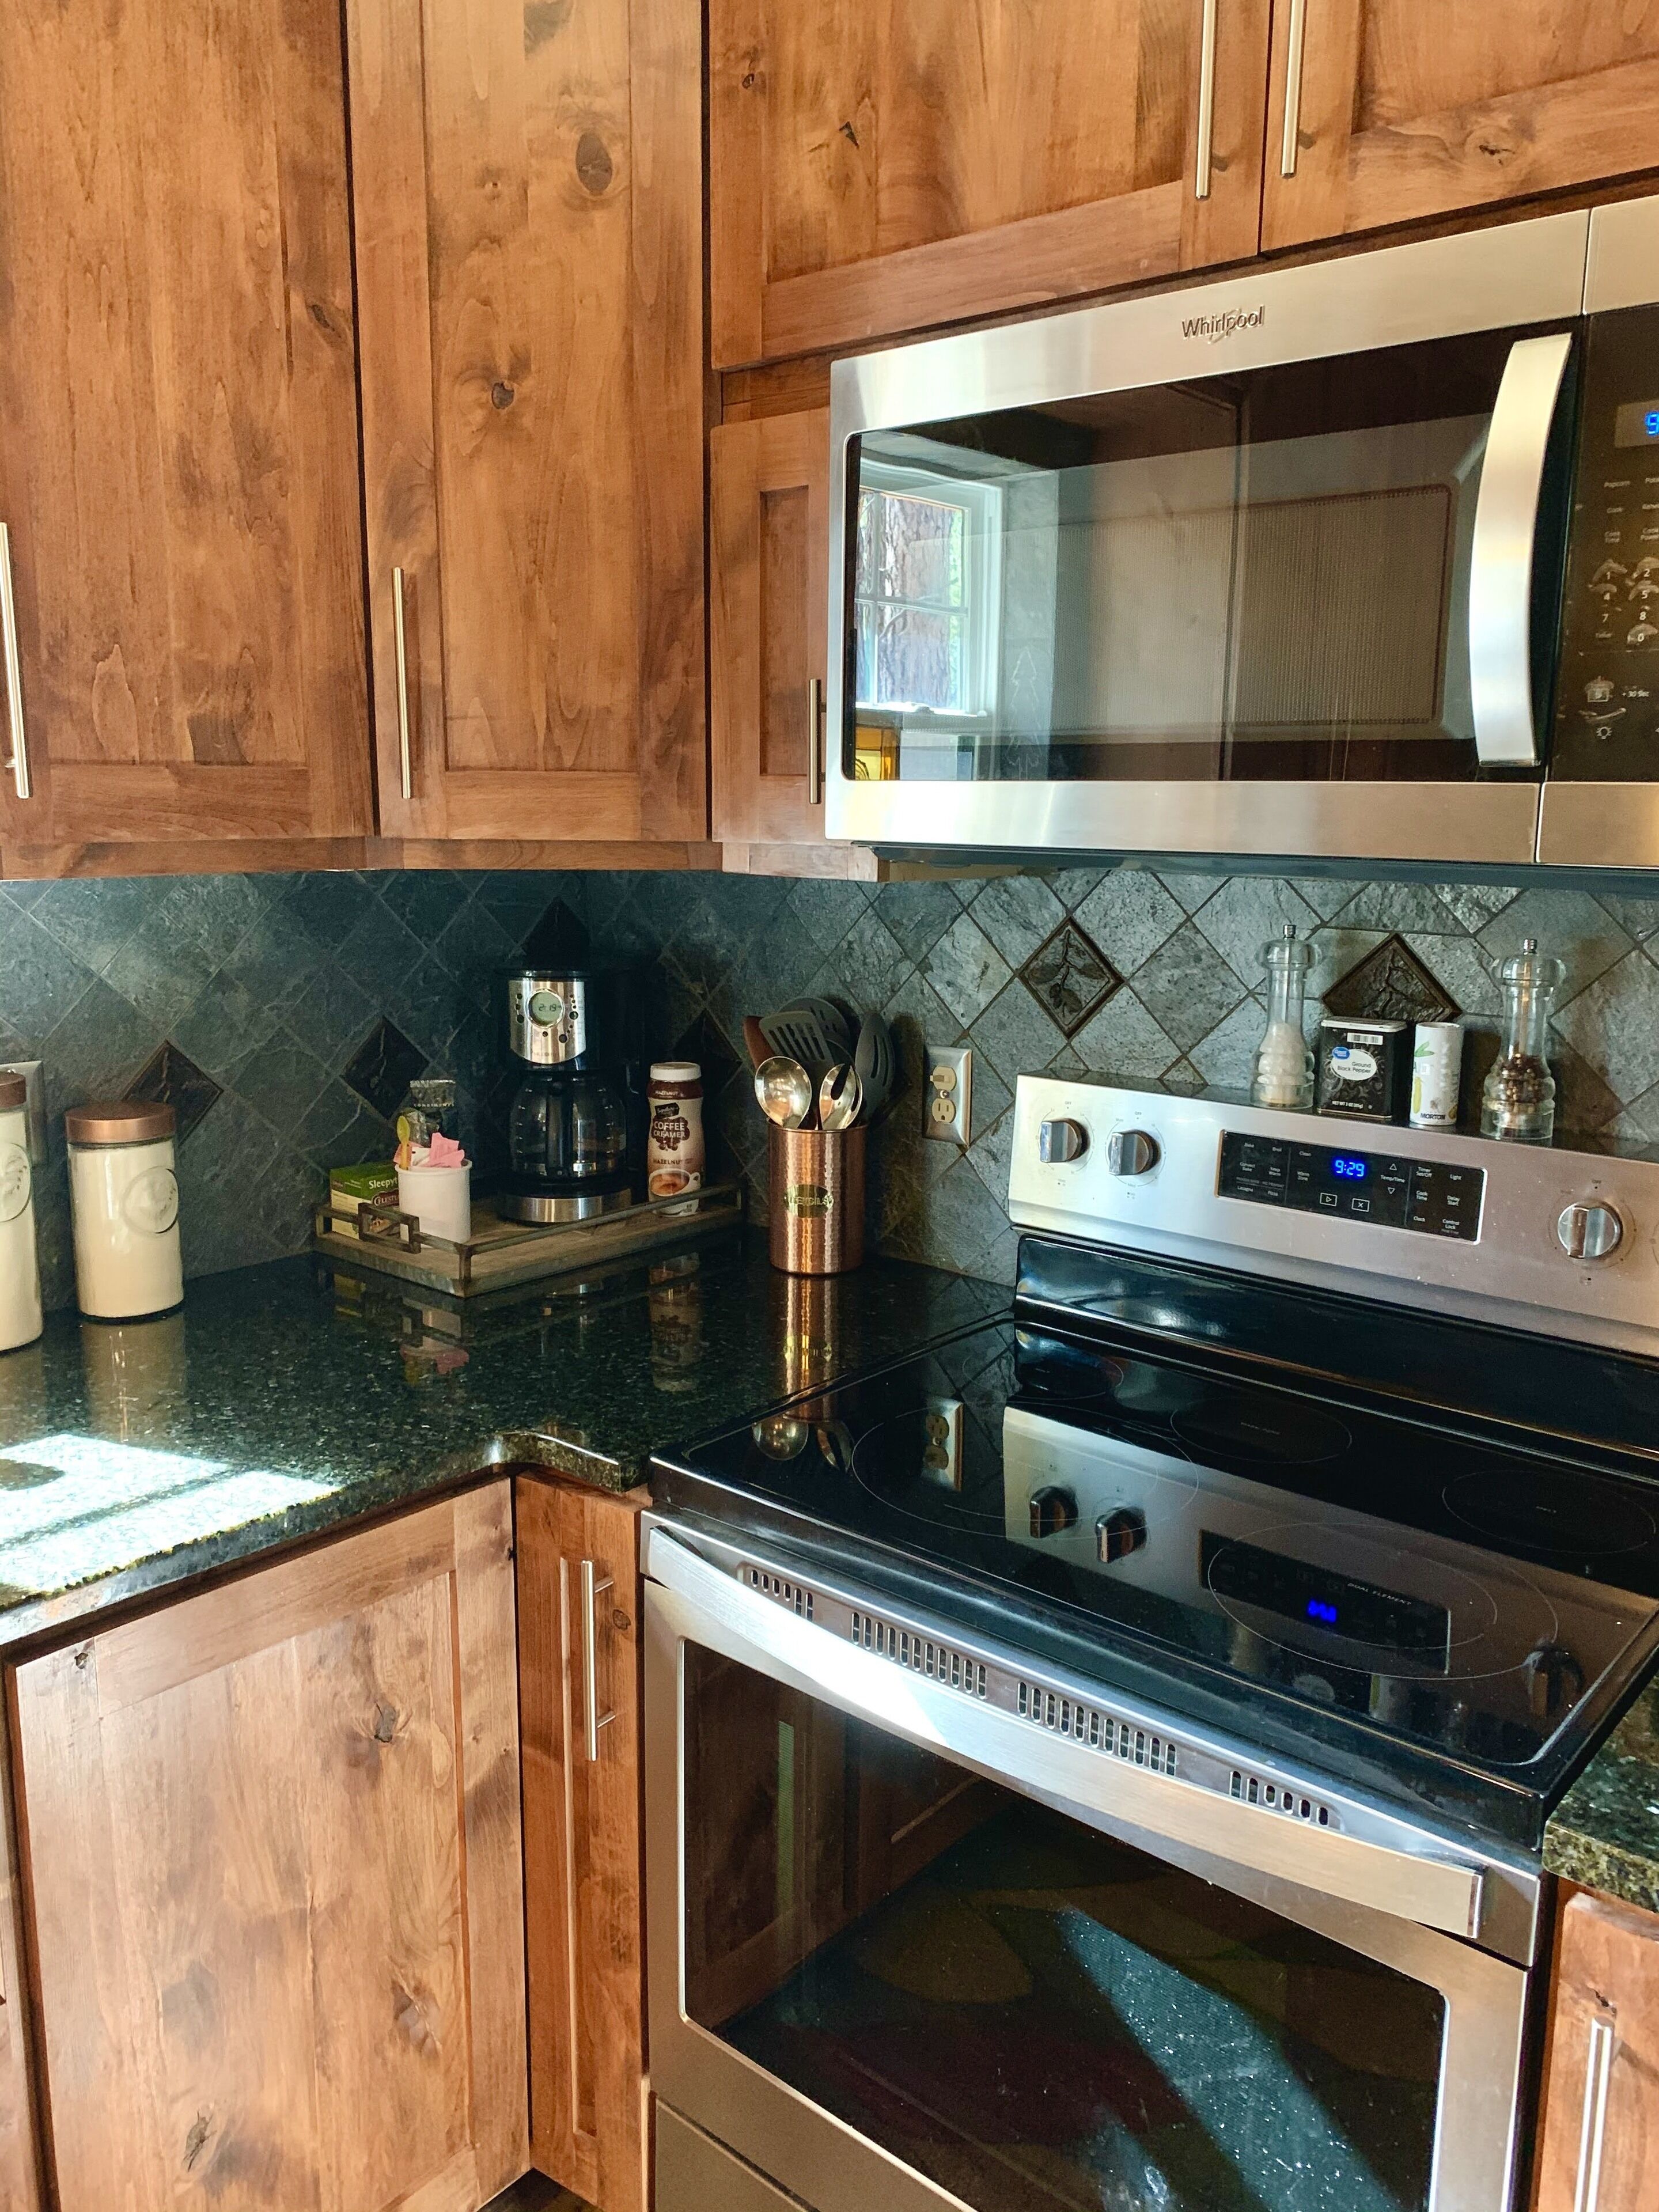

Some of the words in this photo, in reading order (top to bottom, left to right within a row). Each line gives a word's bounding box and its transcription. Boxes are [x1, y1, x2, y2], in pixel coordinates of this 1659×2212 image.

[1181, 305, 1264, 338] Whirlpool
[1639, 611, 1646, 620] 8
[654, 1121, 685, 1131] COFFEE
[653, 1130, 685, 1138] CREAMER
[1335, 1160, 1365, 1177] 9:29
